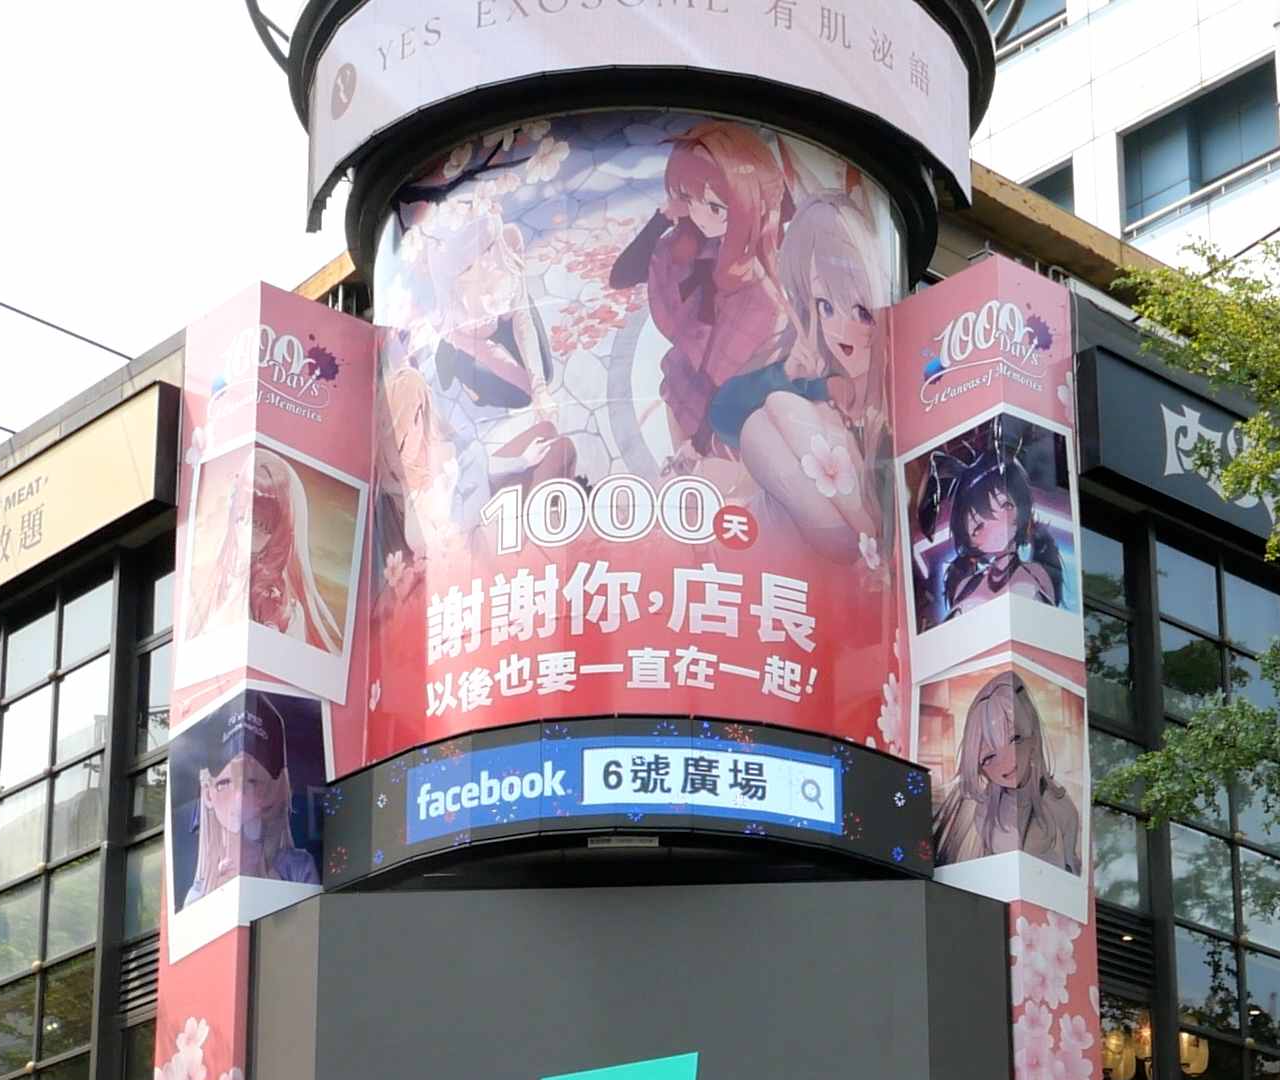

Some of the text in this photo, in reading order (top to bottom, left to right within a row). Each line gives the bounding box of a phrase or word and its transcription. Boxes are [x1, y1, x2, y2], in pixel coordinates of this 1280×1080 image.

[376, 14, 444, 73] YES
[933, 300, 1033, 367] 1000
[417, 760, 573, 820] facebook
[601, 754, 768, 802] 6號廣場
